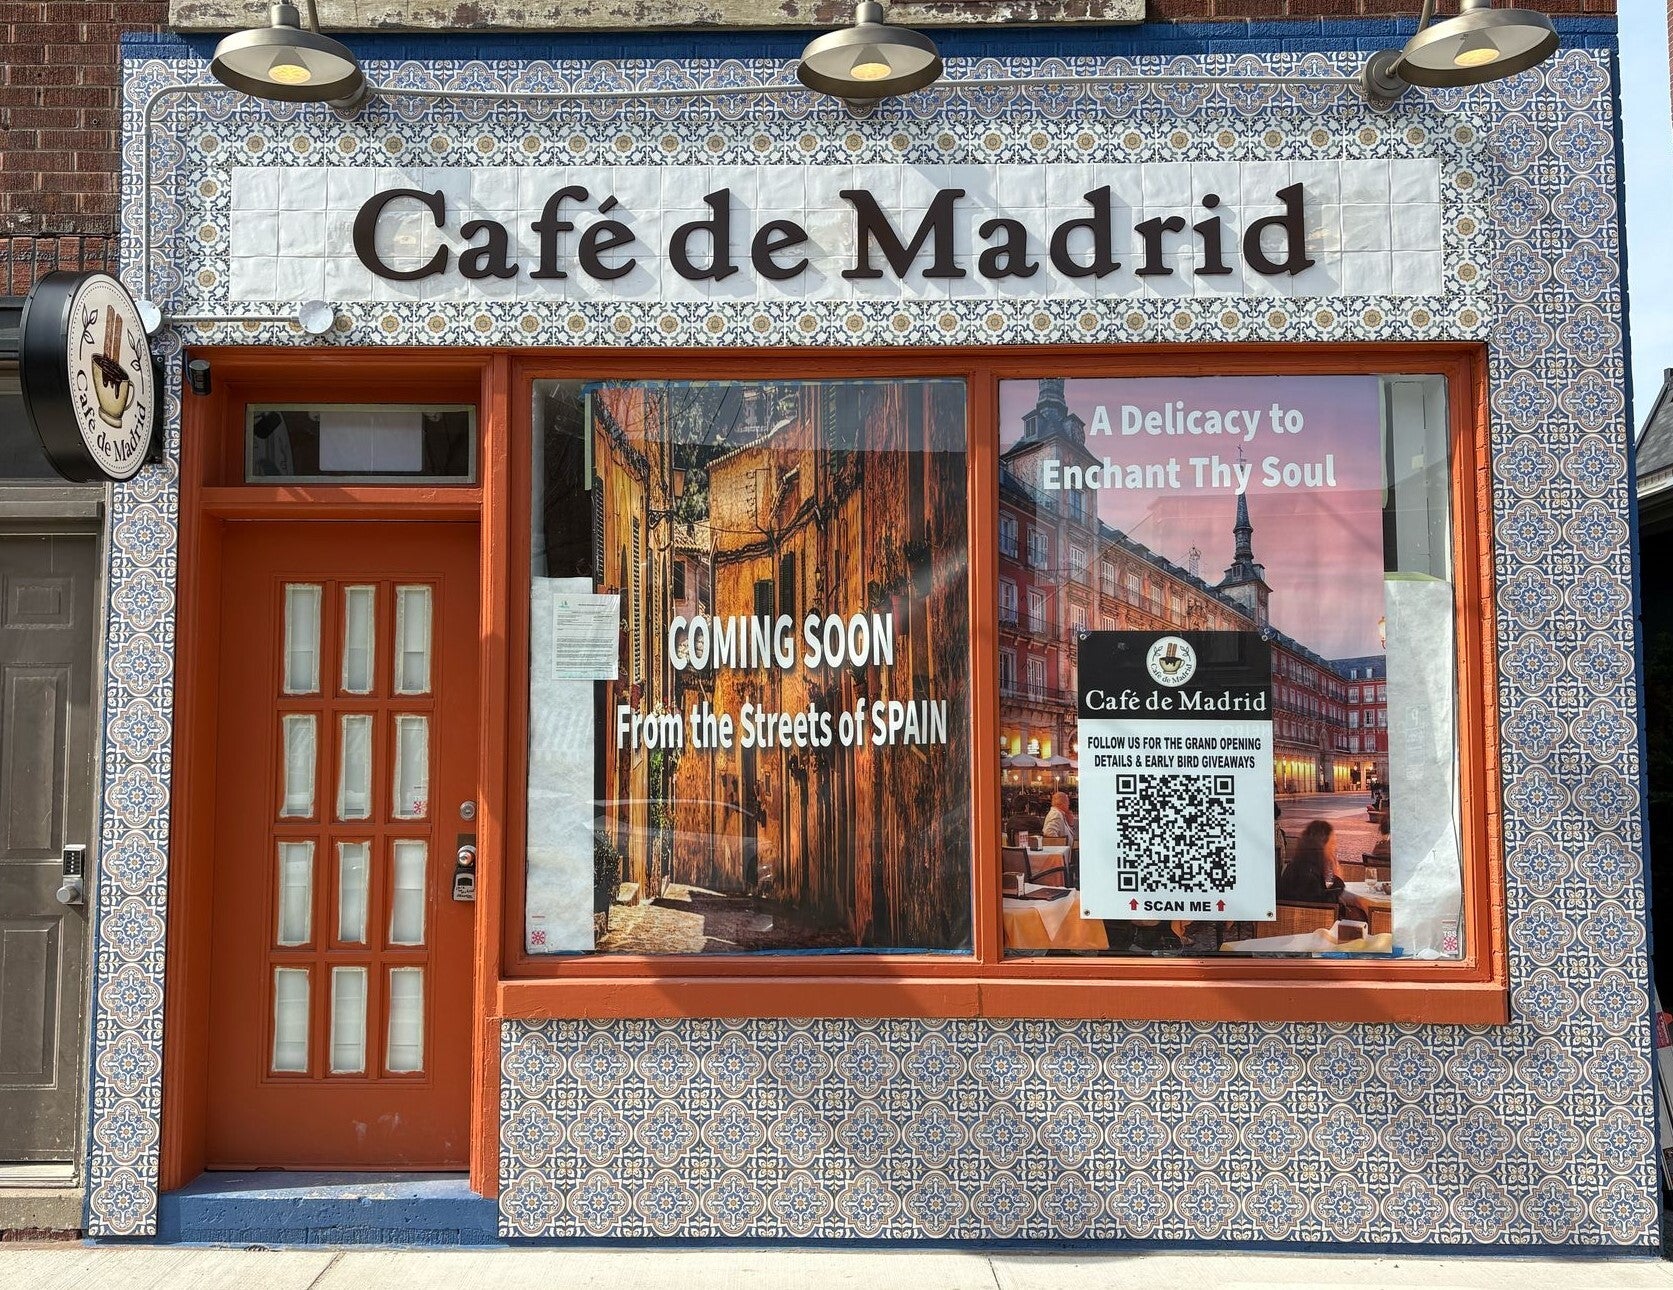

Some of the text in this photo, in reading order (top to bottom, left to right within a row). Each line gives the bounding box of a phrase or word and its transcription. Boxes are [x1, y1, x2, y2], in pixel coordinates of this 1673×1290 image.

[352, 182, 1316, 281] Café de Madrid
[97, 431, 111, 457] de
[113, 400, 146, 462] Madrid
[1089, 400, 1305, 442] A Delicacy to
[1042, 454, 1337, 495] Enchant Thy Soul
[668, 614, 794, 670] COMING
[803, 613, 894, 669] SOON
[1172, 663, 1192, 684] Madrid
[1085, 689, 1267, 712] Café de Madrid
[616, 698, 947, 749] From the Streets of SPAIN
[1087, 736, 1261, 750] FOLLOW US FOR THE GRAND OPENING
[1094, 755, 1255, 768] DETAILS & EARLY BIRD GIVEAWAYS
[1143, 901, 1212, 912] SCAN ME
